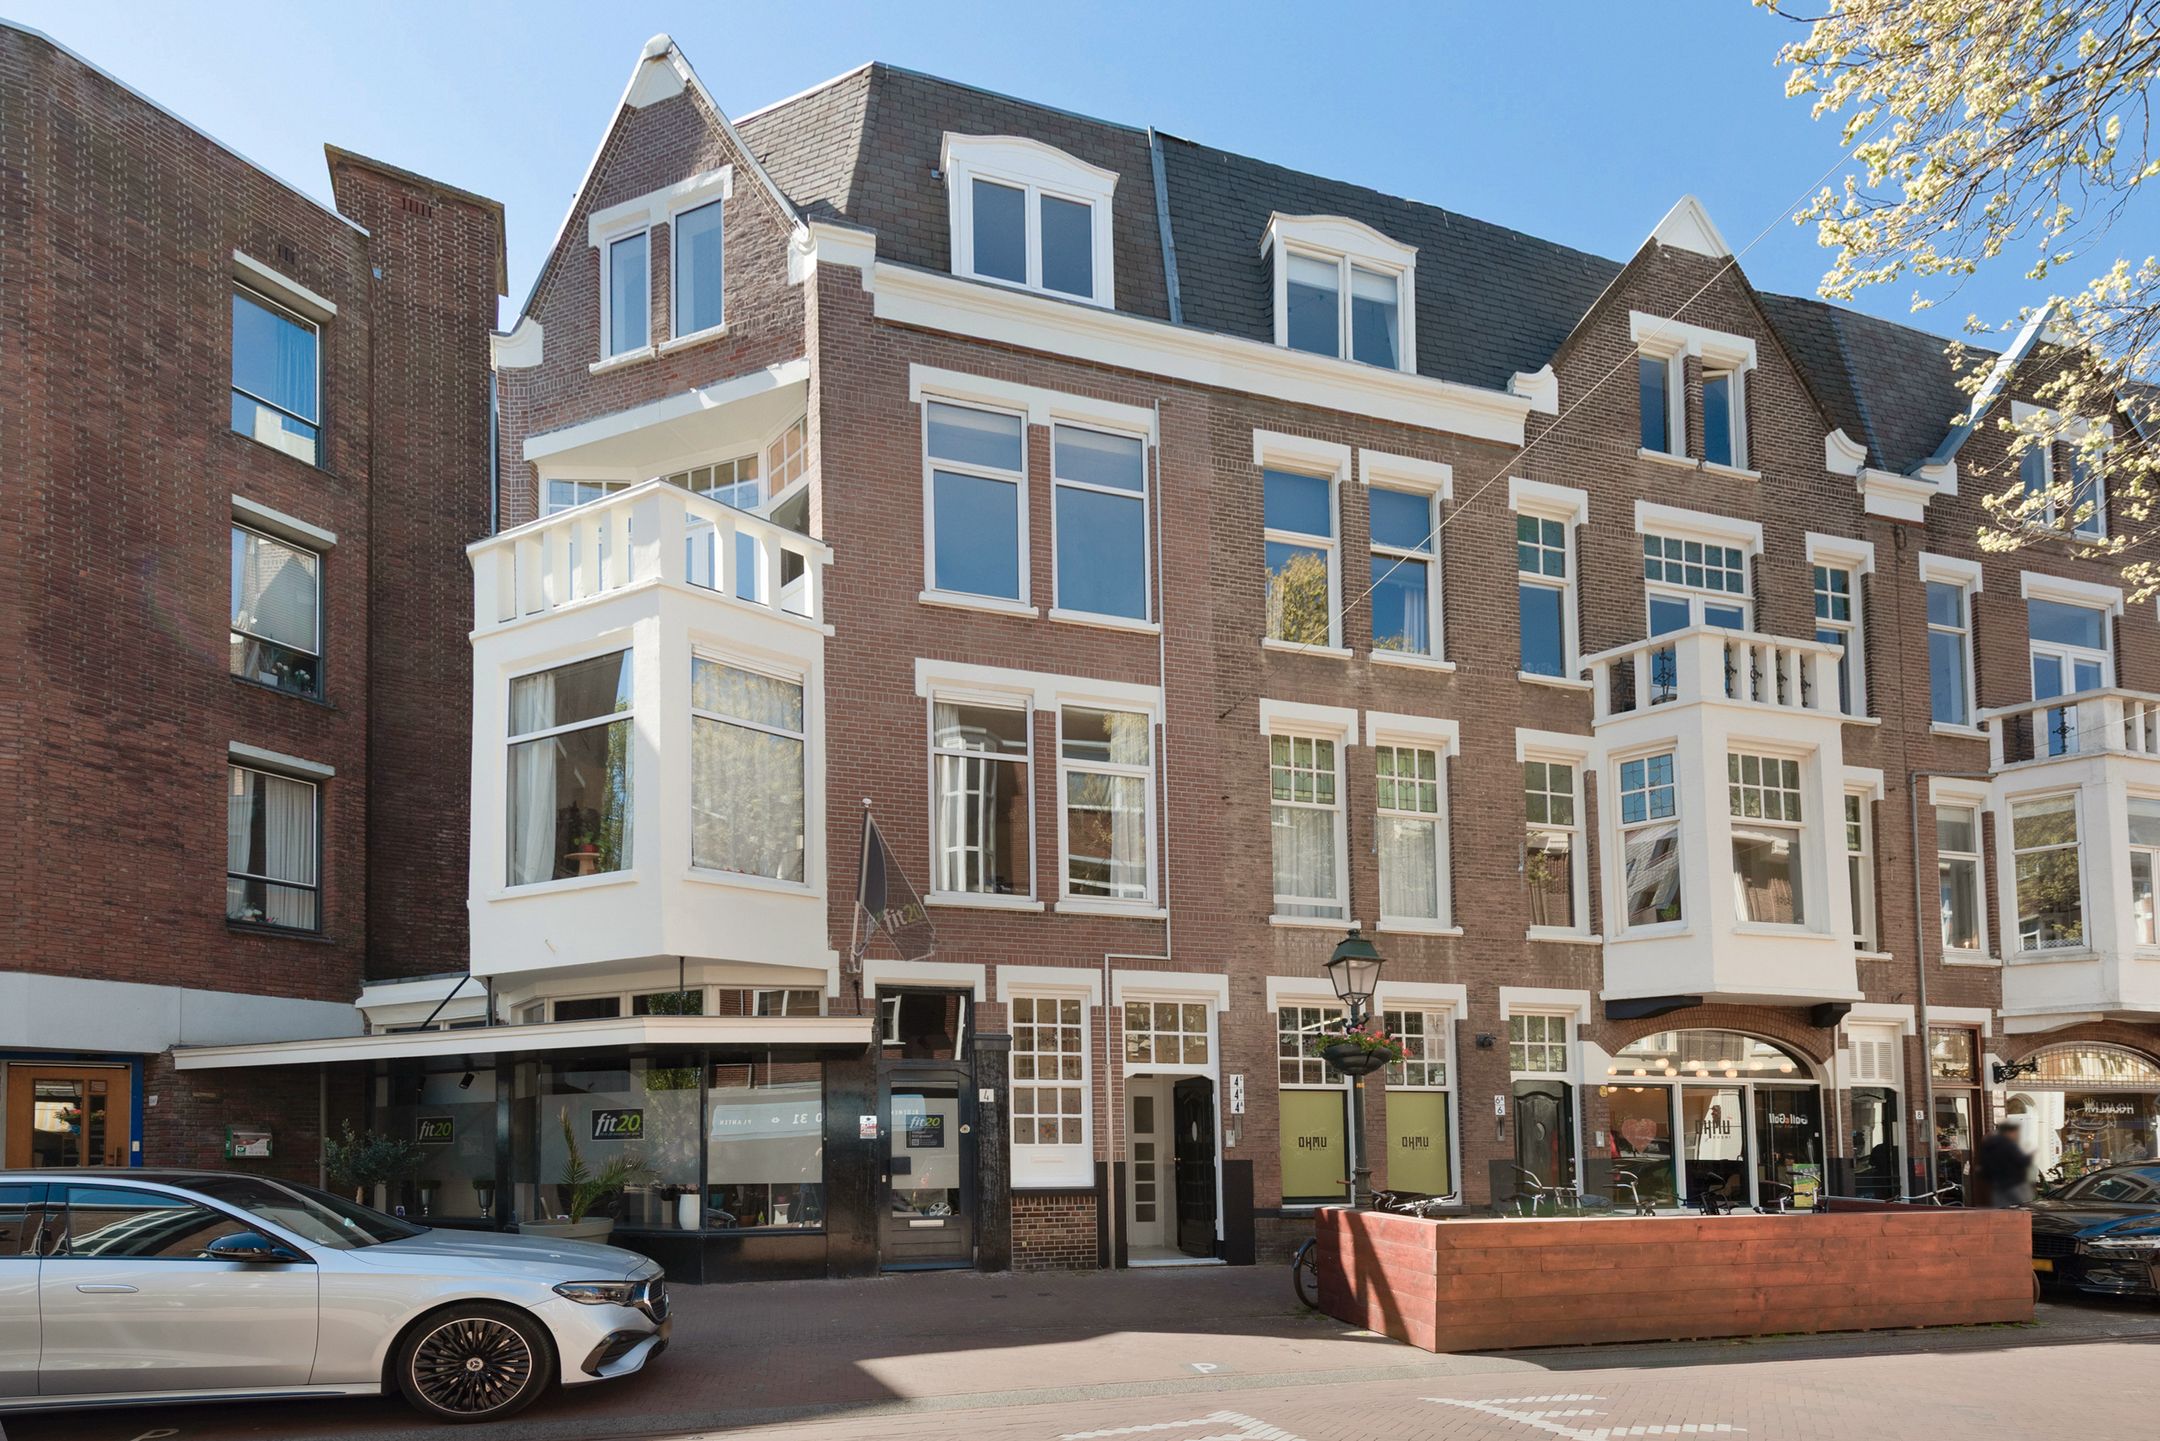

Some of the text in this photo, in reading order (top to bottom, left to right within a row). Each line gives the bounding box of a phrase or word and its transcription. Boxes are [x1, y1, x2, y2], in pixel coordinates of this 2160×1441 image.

[883, 903, 923, 935] fit20
[983, 1089, 990, 1101] 4
[1497, 1106, 1503, 1114] 6
[1917, 1111, 1922, 1119] 8
[594, 1113, 641, 1137] fit20
[909, 1116, 941, 1129] fit20
[419, 1121, 452, 1140] fit20
[1298, 1136, 1327, 1151] OHMU
[1401, 1136, 1429, 1150] OHMU
